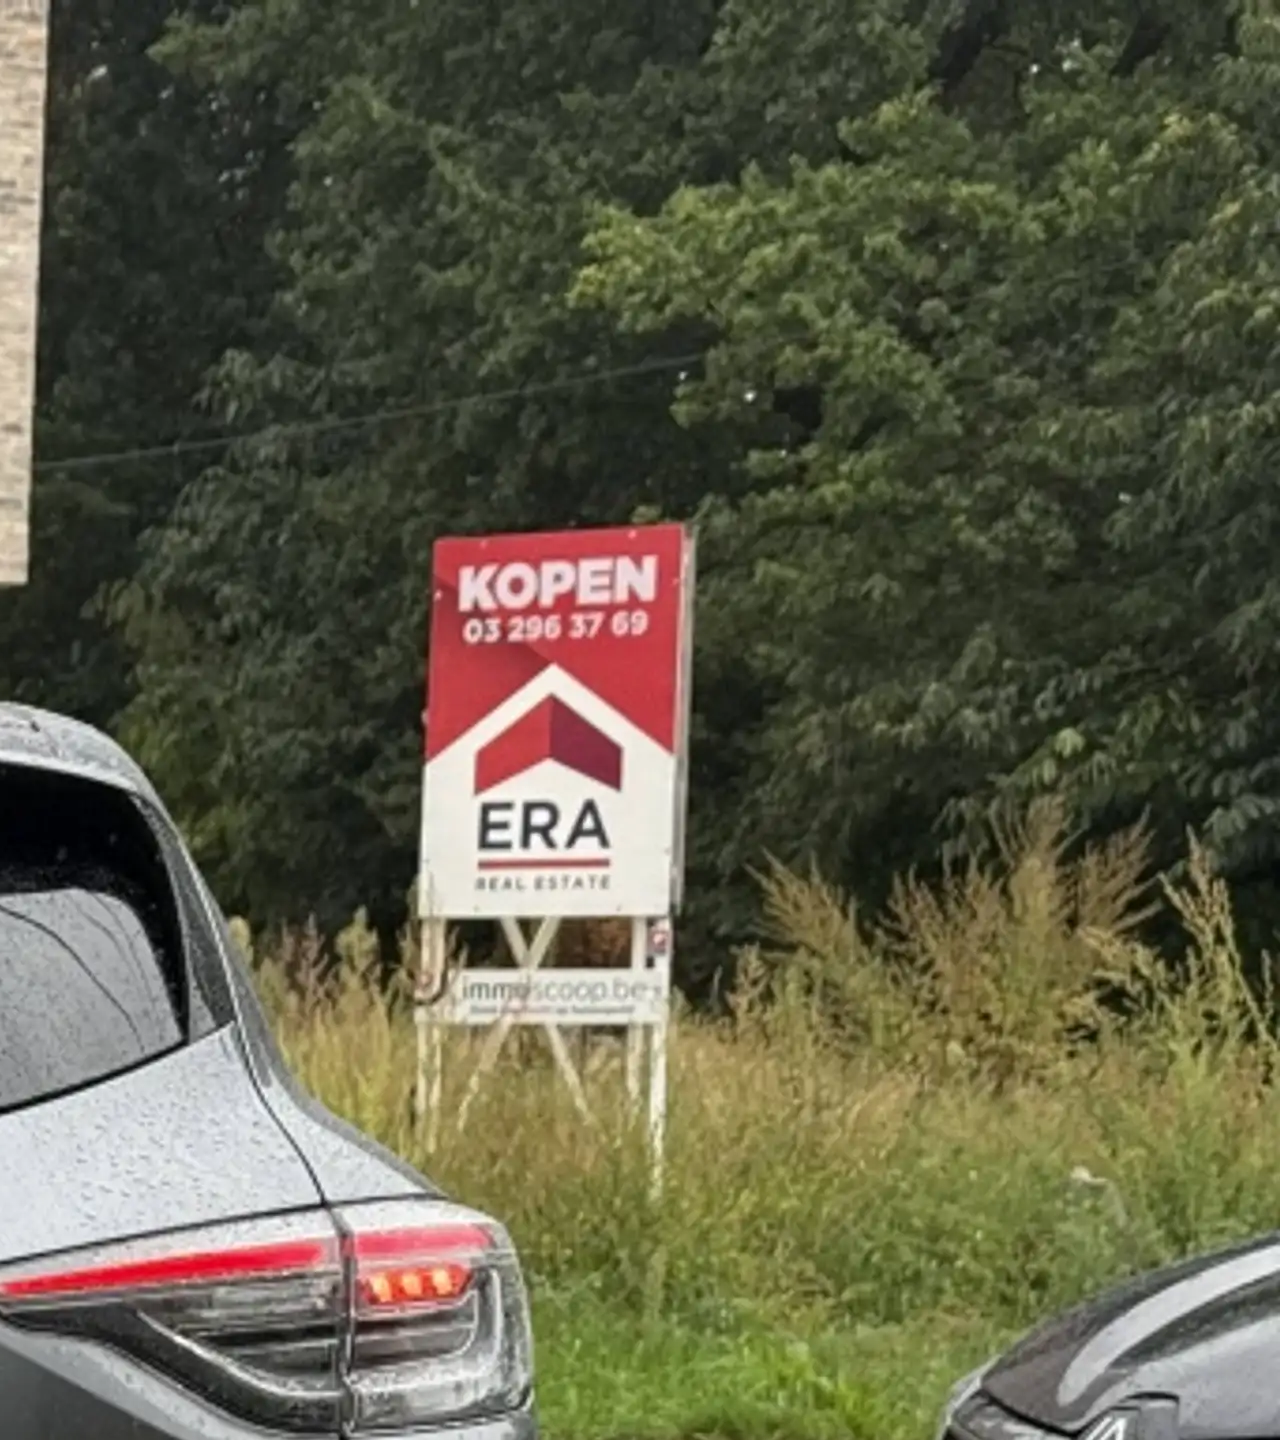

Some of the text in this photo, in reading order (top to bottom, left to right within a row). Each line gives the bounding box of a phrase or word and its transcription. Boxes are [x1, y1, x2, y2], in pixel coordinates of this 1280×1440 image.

[458, 554, 659, 612] KOPEN
[462, 609, 650, 644] 03 296 37 69
[477, 798, 611, 850] ERA
[474, 873, 611, 891] REAL ESTATE
